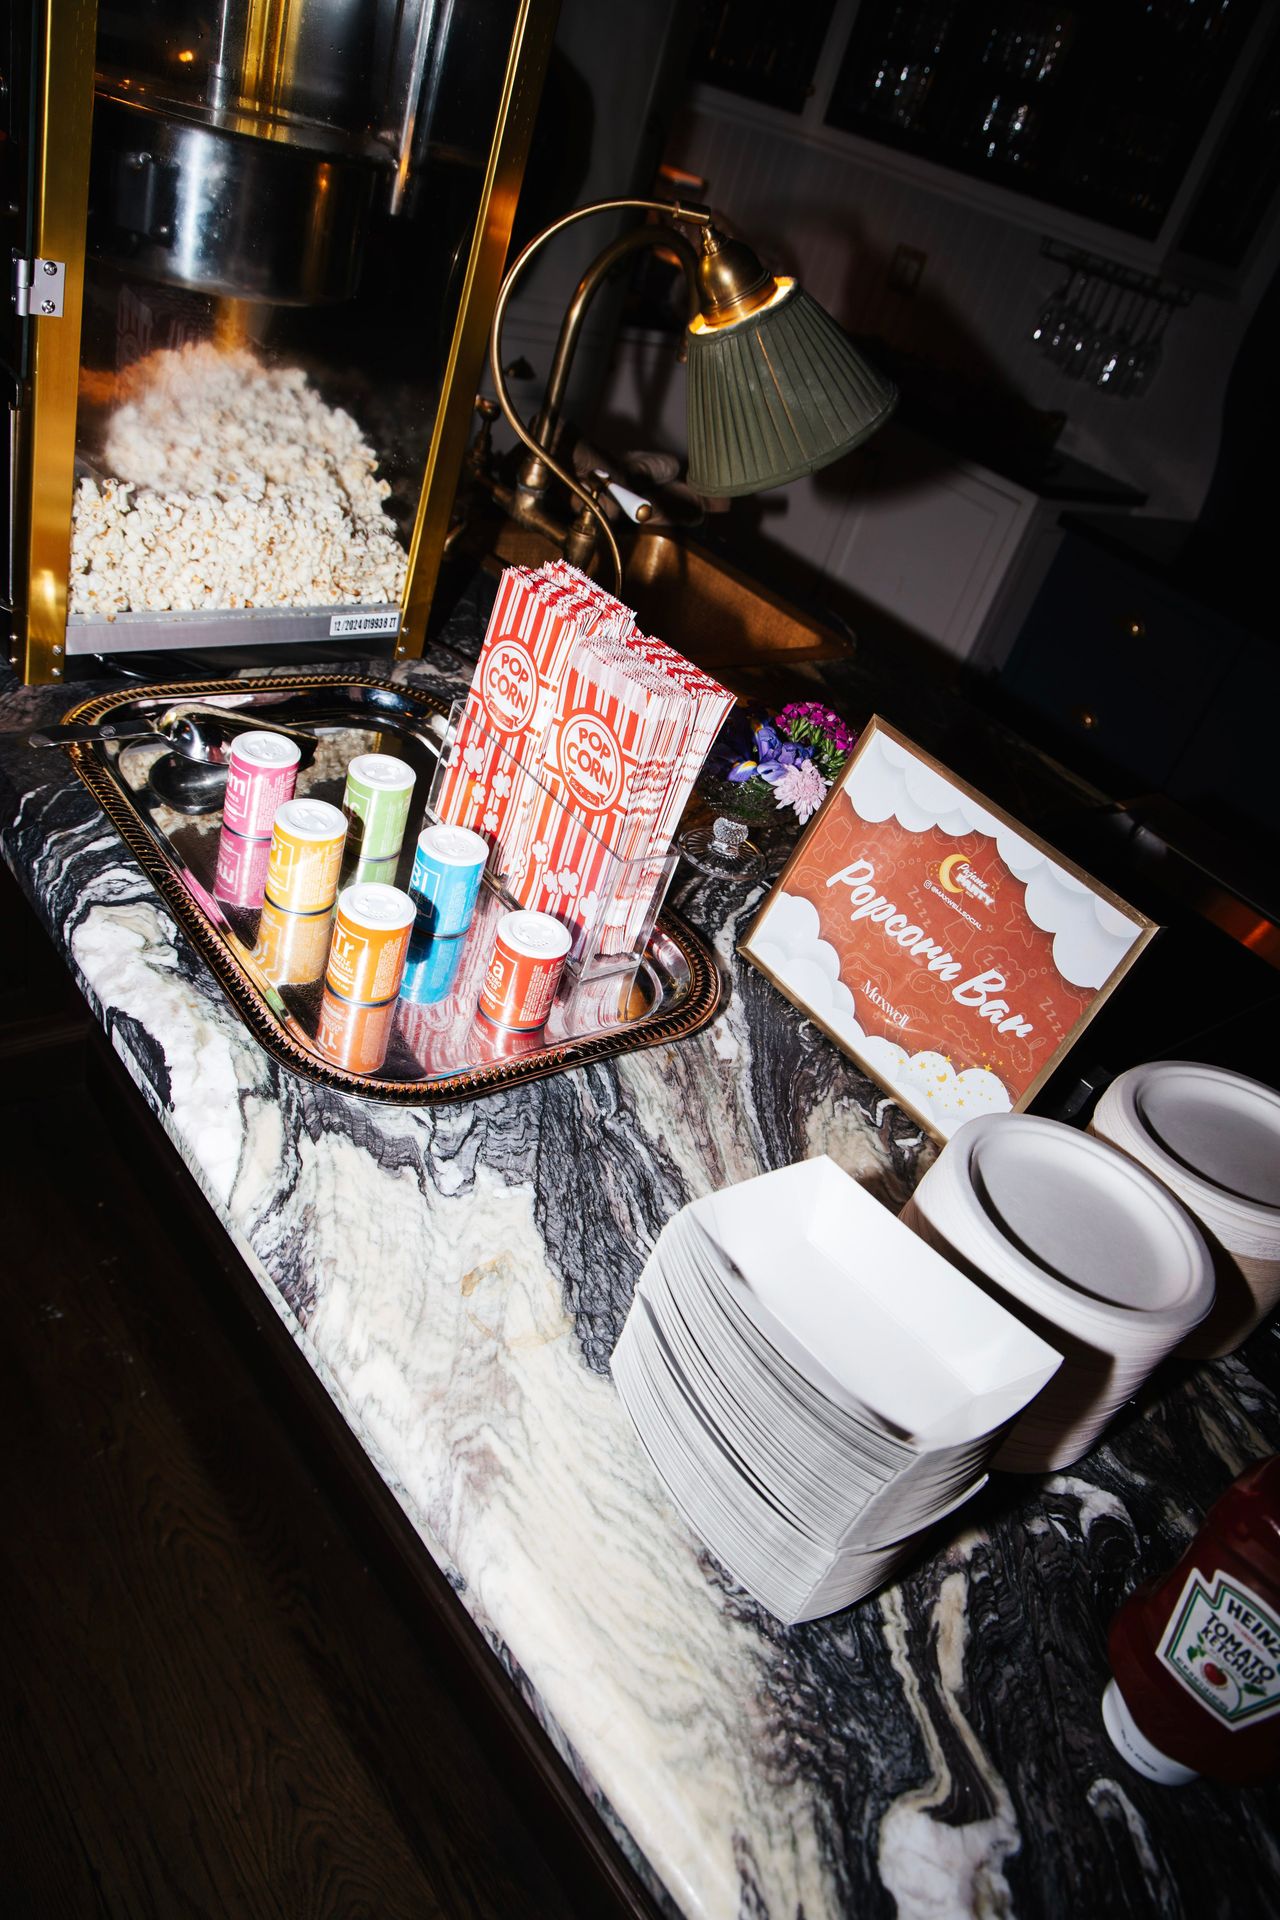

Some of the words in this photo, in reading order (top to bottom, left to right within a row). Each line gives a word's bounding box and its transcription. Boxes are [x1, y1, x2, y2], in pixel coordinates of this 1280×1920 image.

[488, 667, 529, 714] CORN
[501, 652, 529, 683] POP
[578, 726, 611, 759] POP
[227, 772, 247, 798] m
[566, 741, 613, 792] CORN
[955, 872, 996, 907] PARTY
[956, 862, 990, 890] Pajama
[930, 885, 983, 931] @MAXWELLSOCIAL
[334, 924, 355, 959] Tr
[825, 857, 962, 983] Popcorn
[951, 967, 1035, 1039] Bar
[859, 977, 910, 1032] Maxwell
[1205, 1611, 1276, 1682] TOMATO
[1226, 1598, 1280, 1660] HEINZ
[1200, 1625, 1265, 1686] KETCHUP
